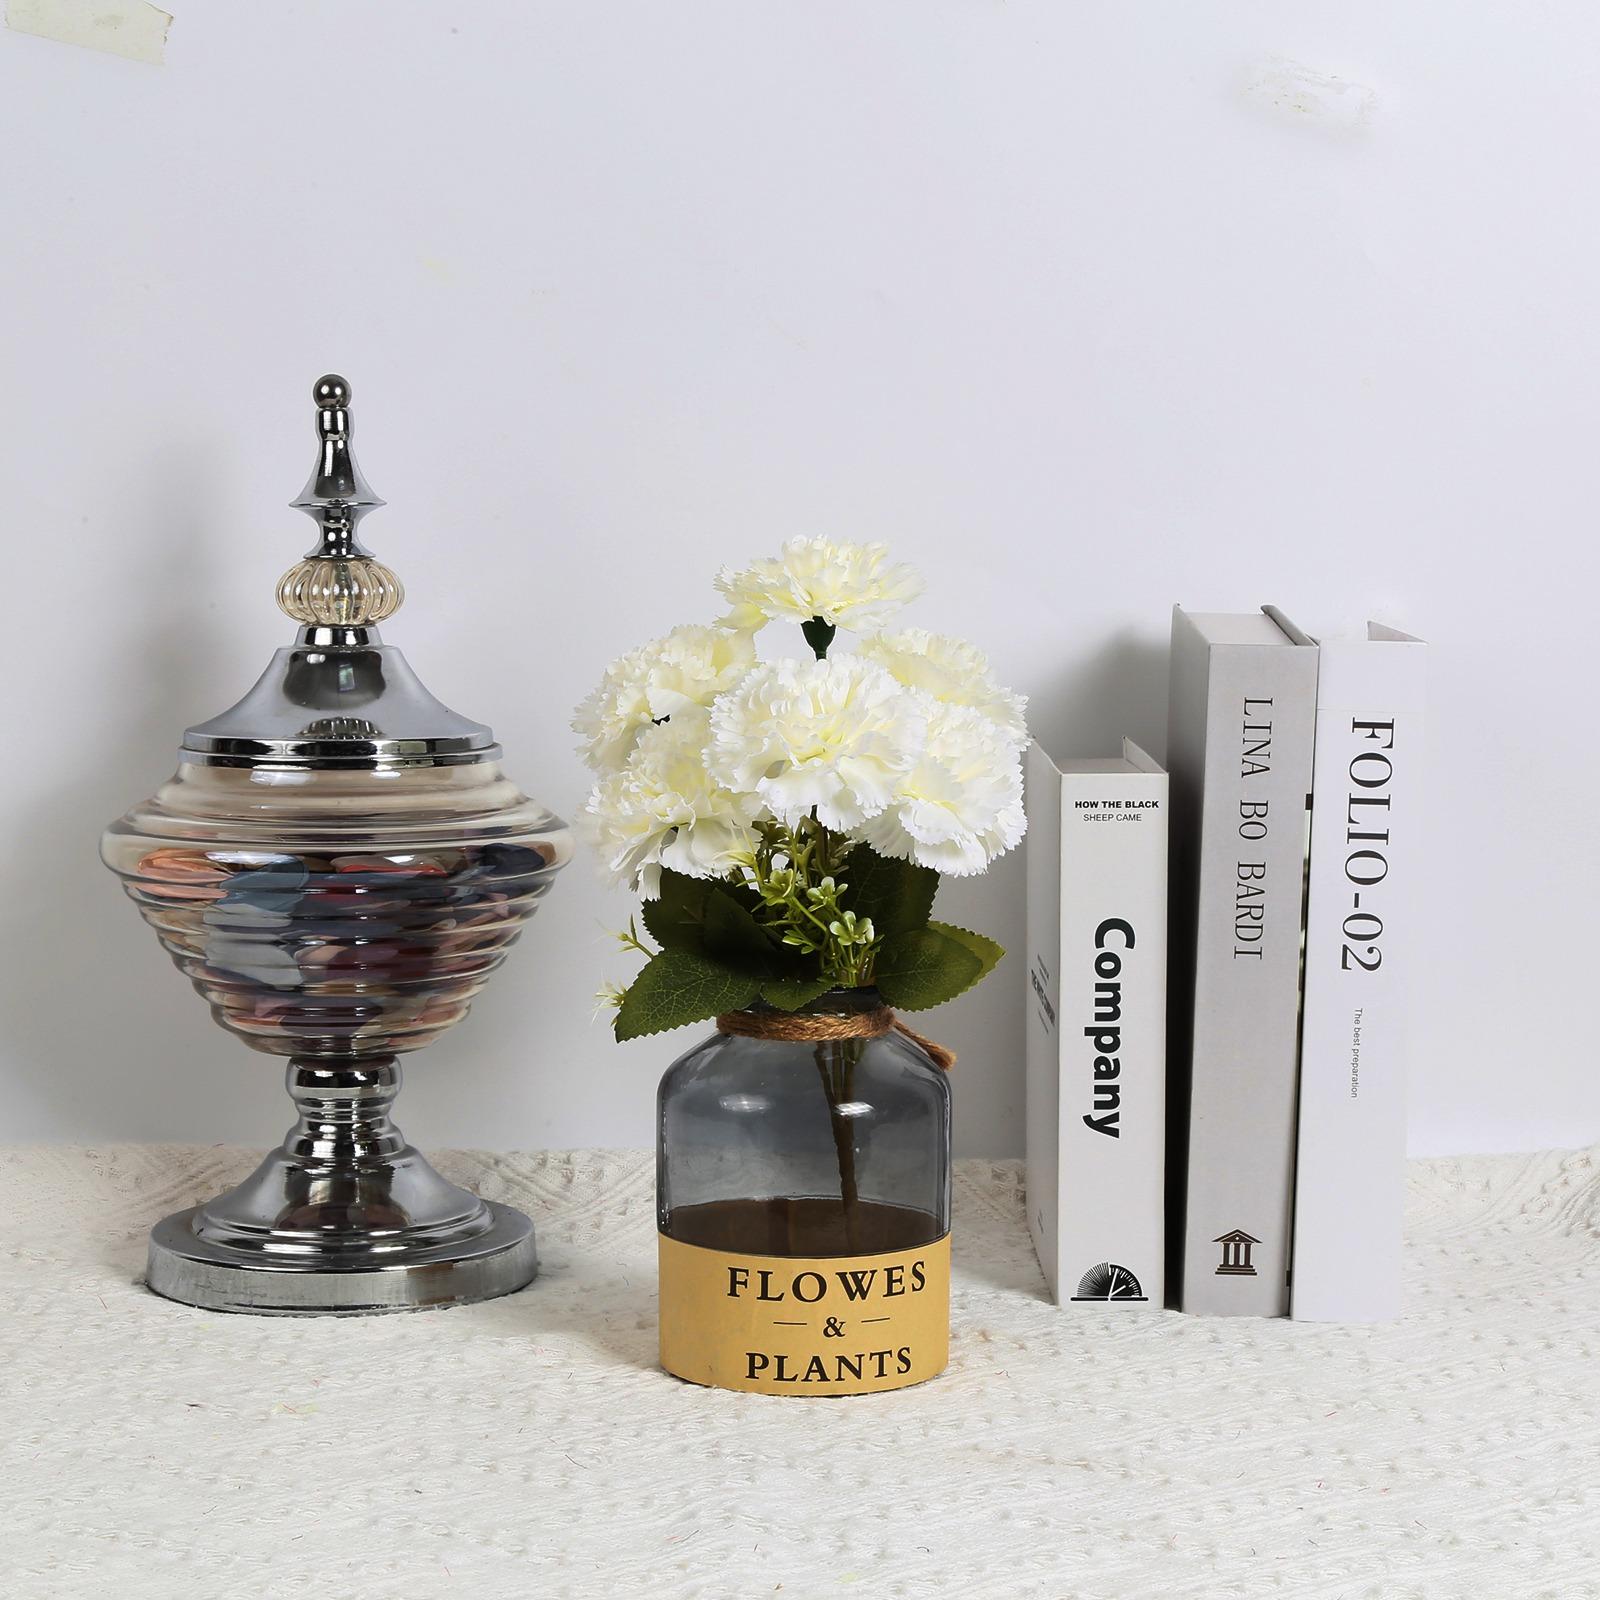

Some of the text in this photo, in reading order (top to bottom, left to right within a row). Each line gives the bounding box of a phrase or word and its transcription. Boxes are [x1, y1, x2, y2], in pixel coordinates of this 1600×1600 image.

[1074, 800, 1159, 809] HOW THE BLACK
[1083, 813, 1142, 822] SHEEP CAME
[1233, 696, 1274, 960] LINA BO BARDI
[1341, 716, 1395, 972] FOLIO-02
[1082, 917, 1136, 1139] Company
[1350, 1008, 1363, 1098] The best preparation
[726, 1260, 927, 1303] FLOWES
[822, 1316, 846, 1338] &
[745, 1346, 912, 1382] PLANTS
